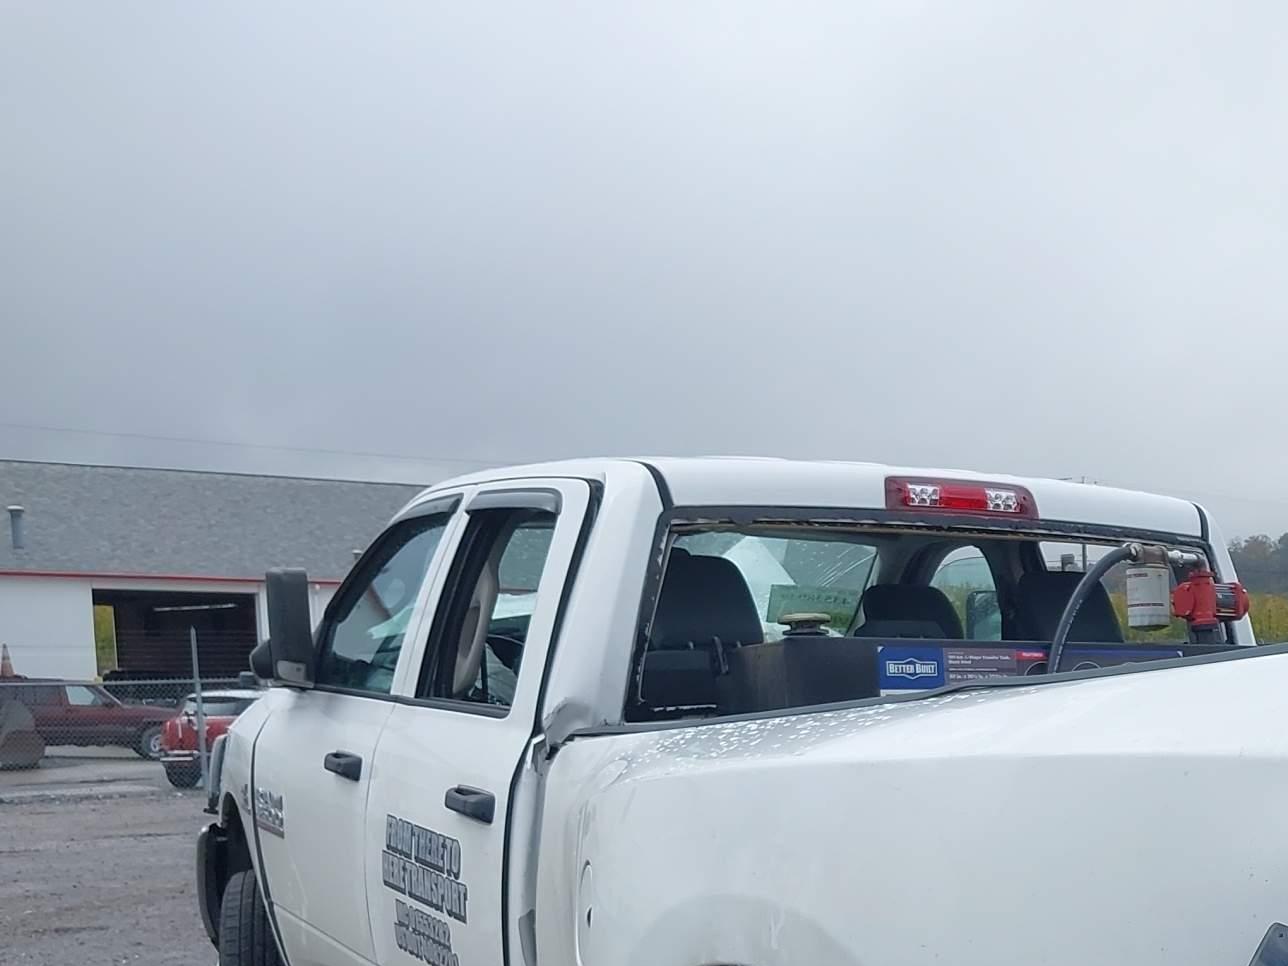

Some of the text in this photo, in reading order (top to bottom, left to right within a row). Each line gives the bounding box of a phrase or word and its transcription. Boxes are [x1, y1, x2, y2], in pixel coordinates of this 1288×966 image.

[889, 663, 935, 674] BETTER BUILT
[386, 814, 461, 880] FROM THERE TO
[382, 850, 468, 924] HERE TRANSPORT
